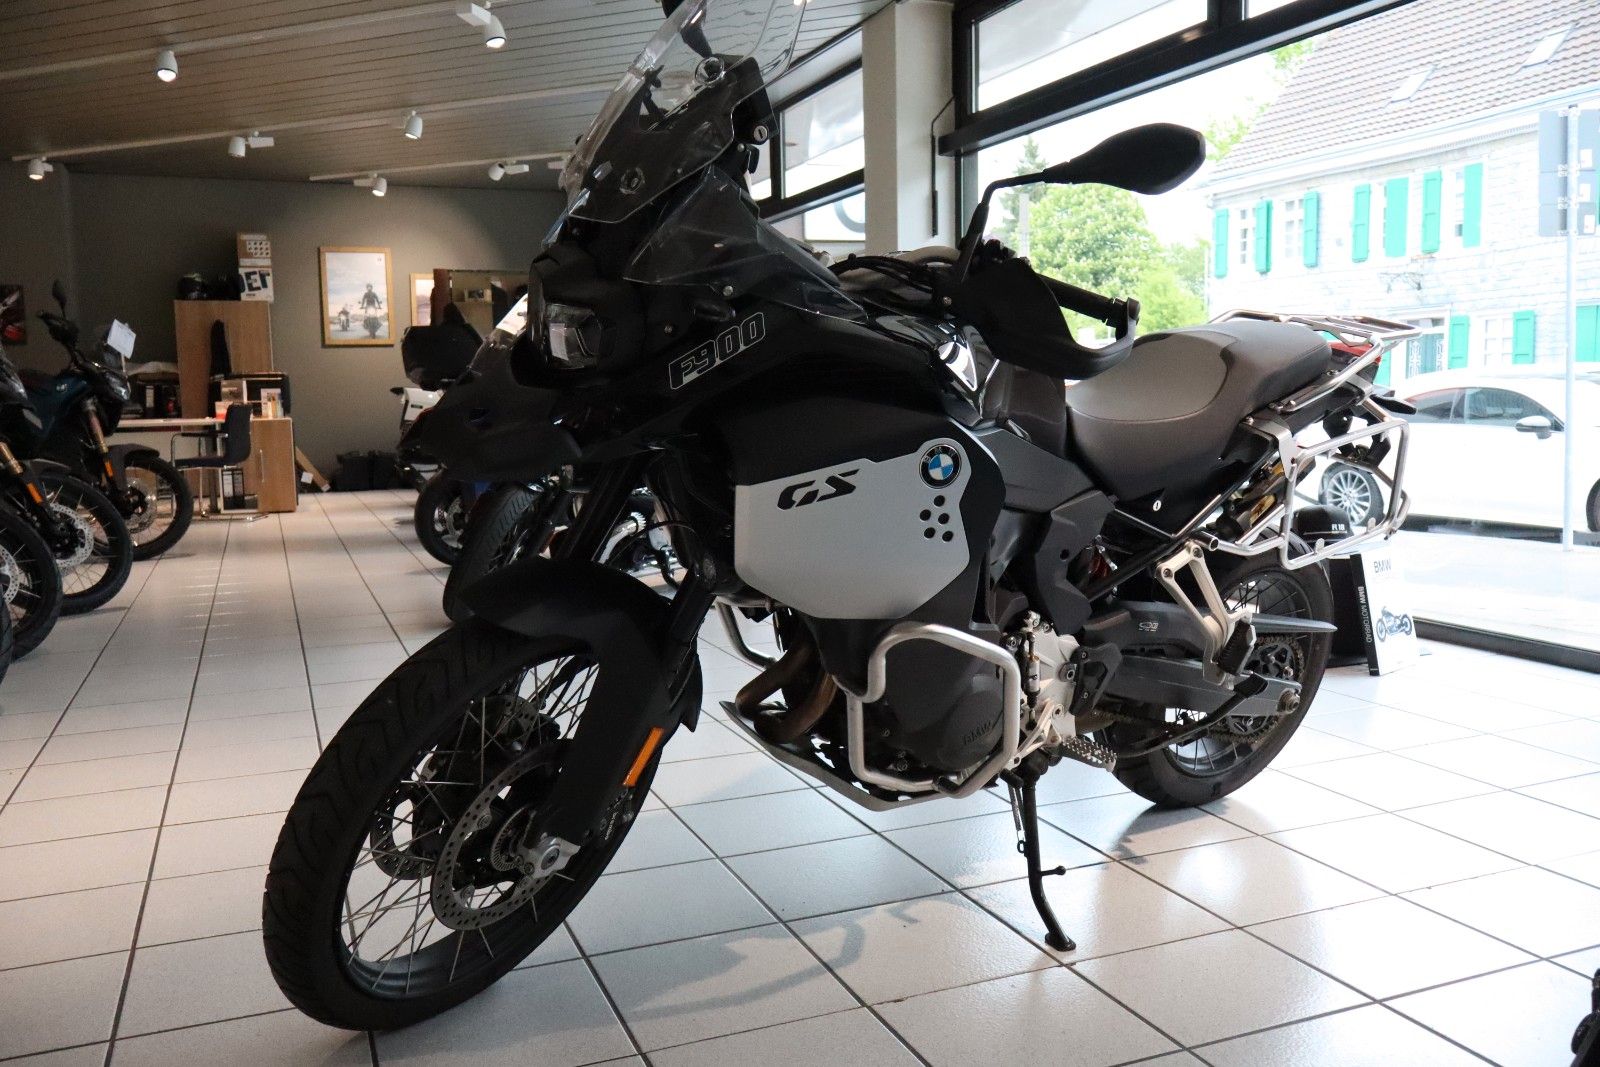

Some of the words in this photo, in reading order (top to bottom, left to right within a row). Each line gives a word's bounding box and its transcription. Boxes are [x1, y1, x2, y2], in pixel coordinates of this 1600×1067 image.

[668, 312, 765, 390] F900
[777, 468, 860, 511] GS
[1373, 559, 1392, 574] BMW
[1357, 586, 1367, 604] BMW
[1362, 604, 1373, 643] MOTORRAD
